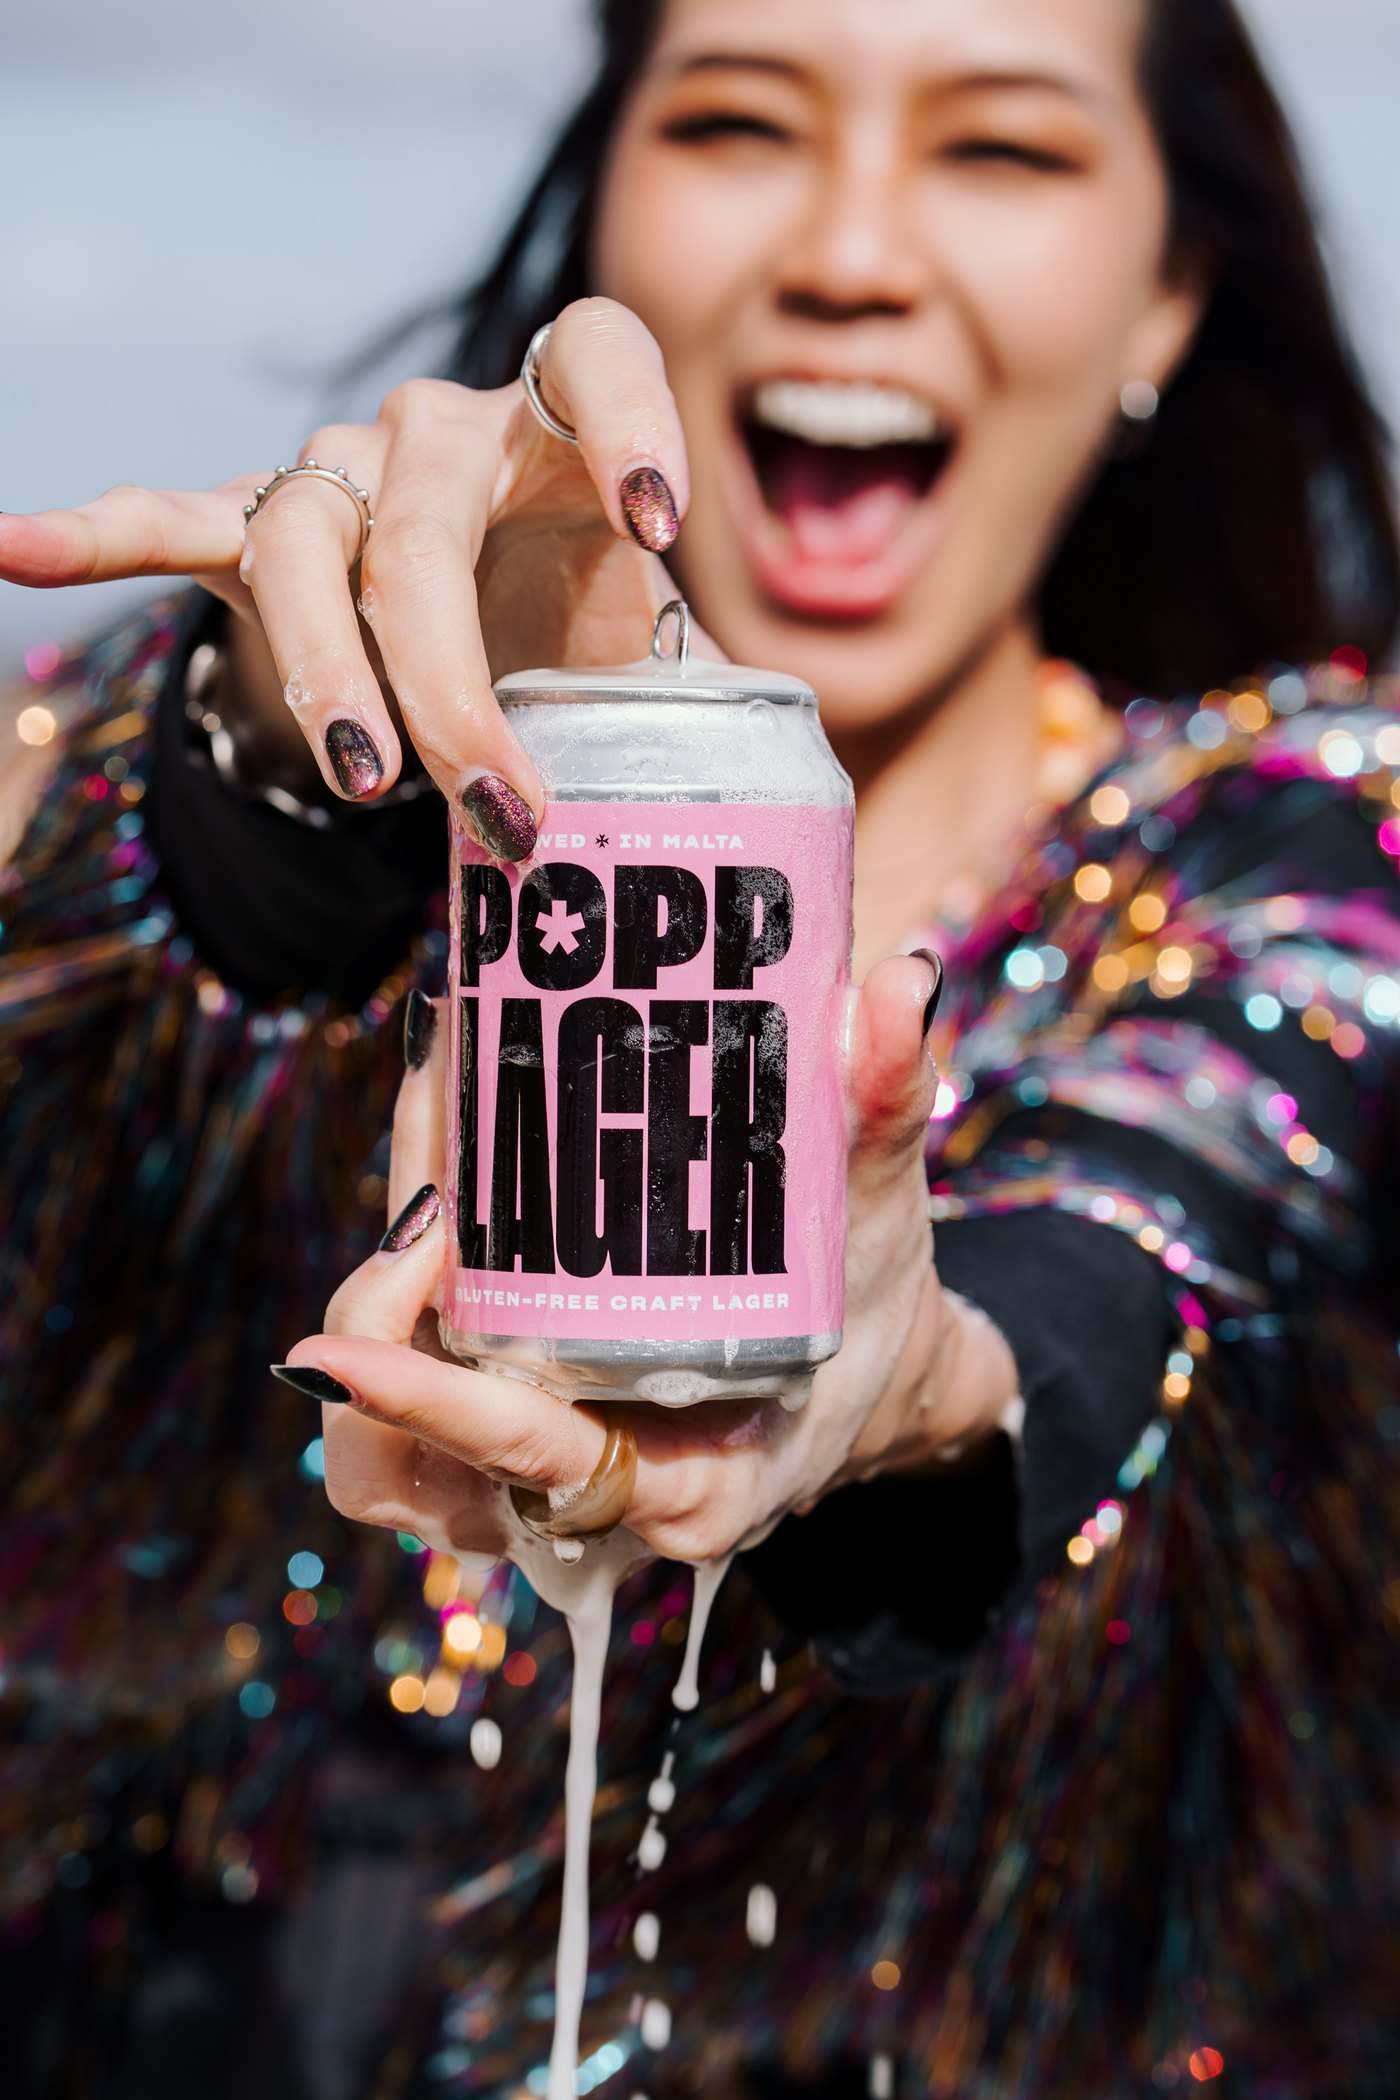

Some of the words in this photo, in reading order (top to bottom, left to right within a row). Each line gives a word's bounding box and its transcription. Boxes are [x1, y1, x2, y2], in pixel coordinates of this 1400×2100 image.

[536, 833, 586, 849] WED
[619, 833, 652, 849] IN
[663, 833, 744, 849] MALTA
[460, 862, 795, 991] POPP
[457, 996, 789, 1279] LAGER
[610, 1295, 702, 1312] CRAFT
[712, 1292, 790, 1311] LAGER
